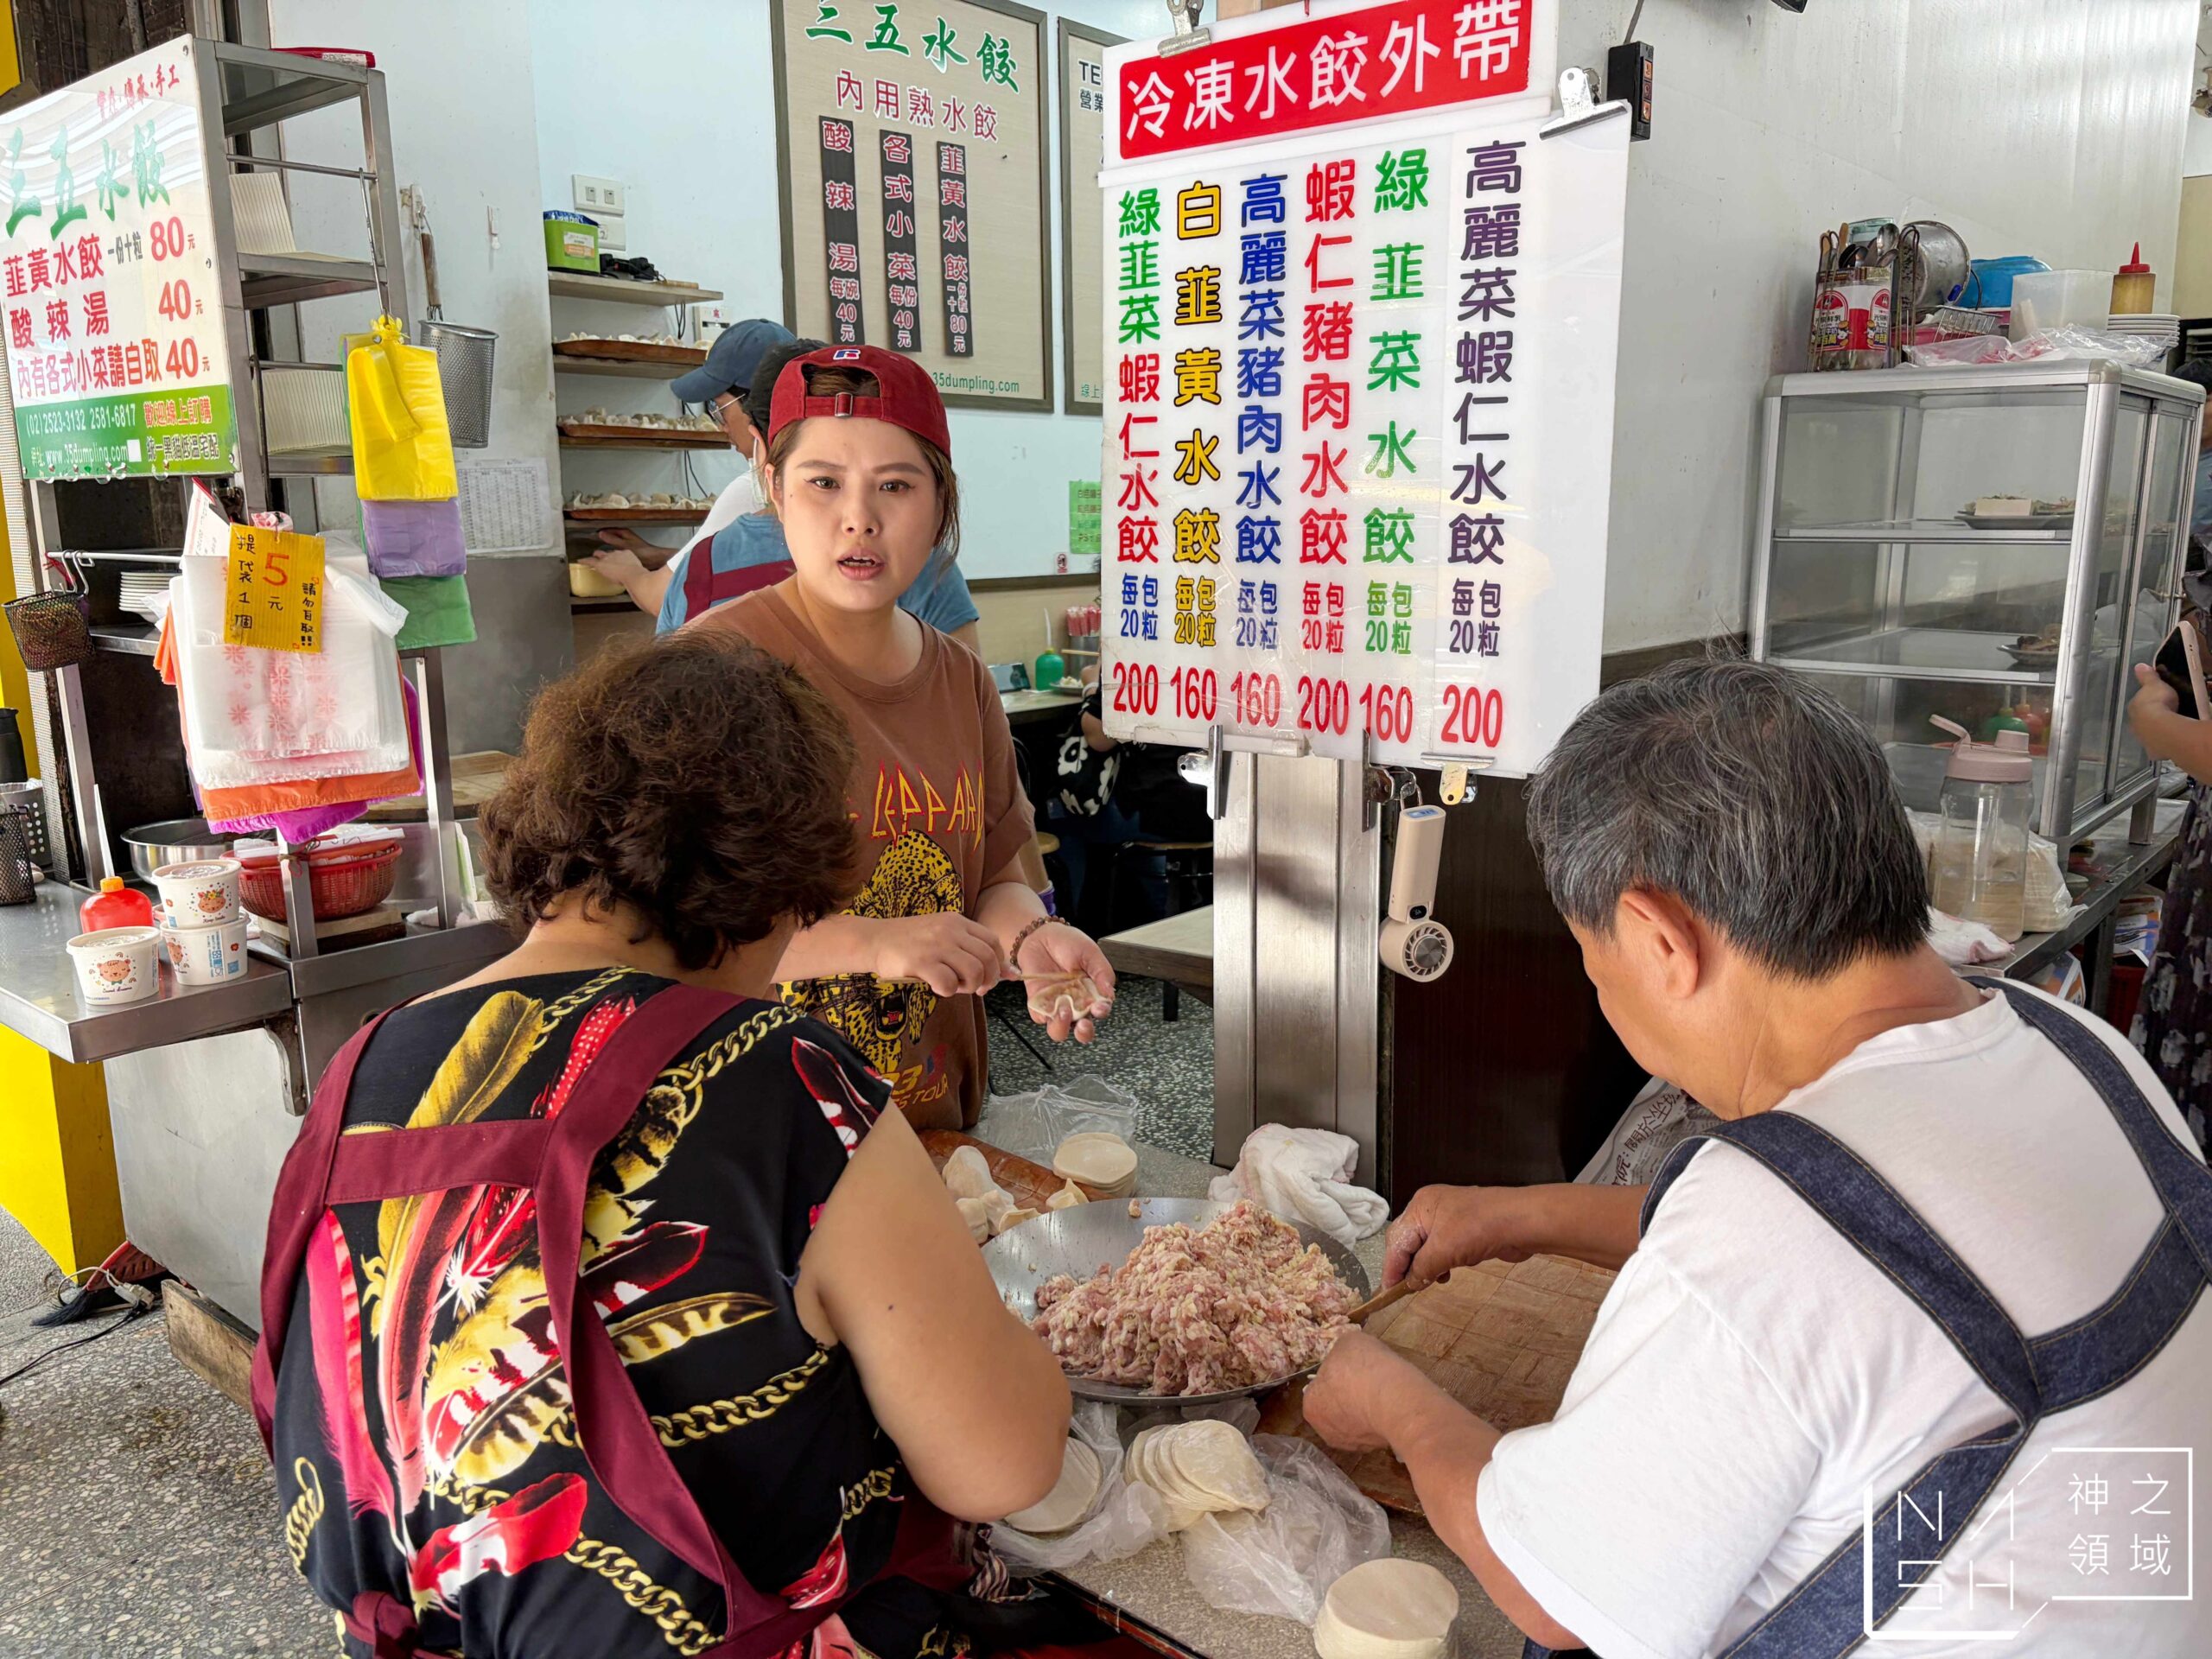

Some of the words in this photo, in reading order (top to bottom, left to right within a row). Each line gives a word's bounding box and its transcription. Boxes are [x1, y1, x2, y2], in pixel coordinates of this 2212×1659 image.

[1126, 0, 1521, 141] 冷凍水餃外帶
[836, 69, 998, 143] 內用熟水餃
[822, 121, 859, 272] 酸辣湯
[883, 135, 916, 281] 各式小菜
[830, 278, 860, 301] 每碗
[889, 285, 917, 308] 每份
[9, 290, 110, 349] 酸辣湯
[841, 323, 856, 343] 元
[897, 329, 912, 348] 元
[16, 338, 162, 400] 內有各式小菜請自取
[1236, 174, 1287, 564] 高麗菜豬肉水餃
[1299, 159, 1355, 564] 蝦仁豬肉水餃
[1447, 140, 1527, 564] 高麗菜蝦仁水餃
[262, 552, 290, 587] 5
[268, 595, 283, 612] 元
[1122, 574, 1159, 607] 每包
[1175, 575, 1217, 612] 每包
[1237, 580, 1277, 614] 每包
[1302, 582, 1344, 617] 每包
[1366, 580, 1412, 618] 每包
[1452, 578, 1501, 617] 每包
[1121, 608, 1159, 641] 20粒
[1174, 612, 1217, 647] 20粒
[1236, 616, 1278, 650] 20粒
[1301, 619, 1344, 653] 20粒
[1365, 620, 1411, 655] 20粒
[1449, 620, 1500, 657] 20粒
[1113, 662, 1159, 715] 200
[1170, 667, 1217, 721] 160
[1230, 671, 1281, 728] 160
[1297, 676, 1350, 736] 200
[1359, 683, 1413, 744] 160
[1440, 683, 1503, 747] 200
